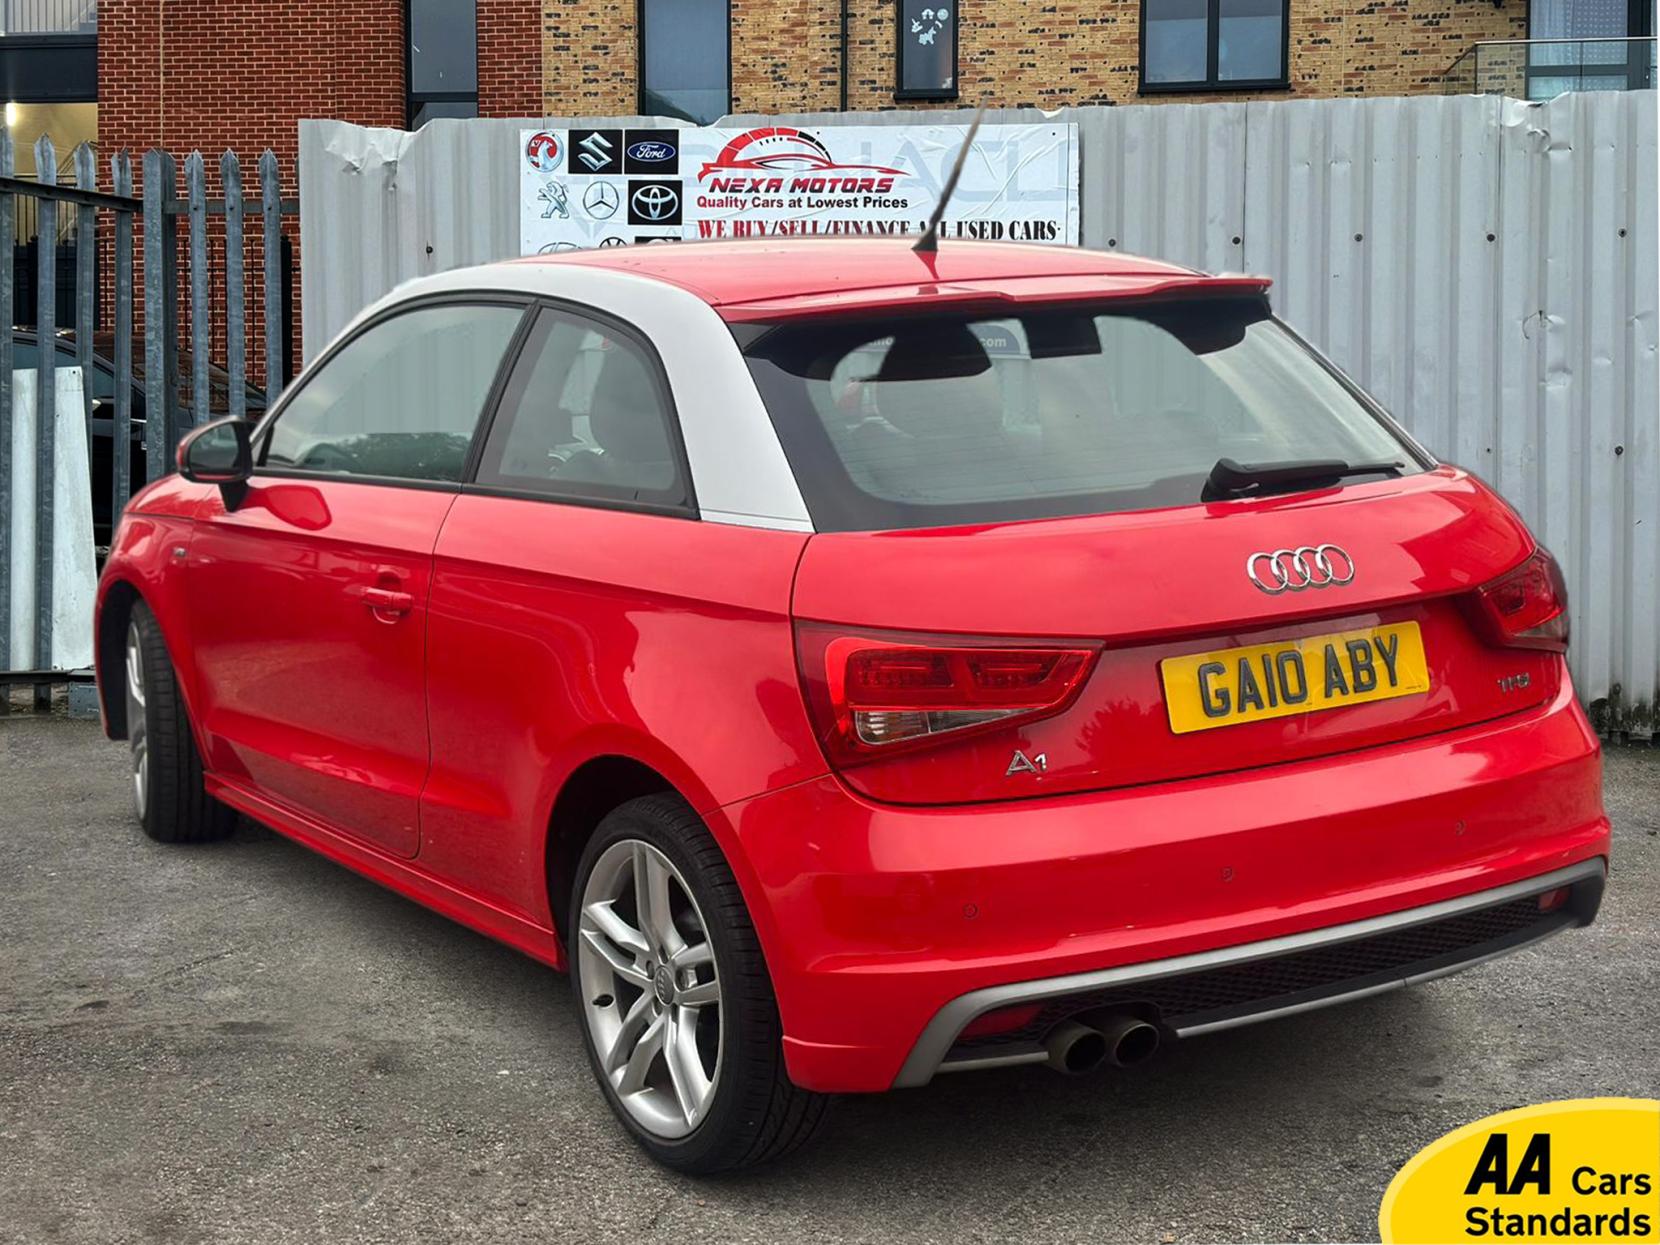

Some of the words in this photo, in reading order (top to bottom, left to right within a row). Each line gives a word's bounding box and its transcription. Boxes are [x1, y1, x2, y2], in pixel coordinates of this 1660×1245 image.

[636, 144, 666, 159] Ford
[708, 177, 784, 194] NEXA
[789, 177, 895, 194] MOTORS
[696, 195, 747, 210] Quality
[751, 195, 783, 208] Cars
[788, 196, 803, 208] at
[807, 195, 860, 208] Lowest
[863, 195, 908, 208] Prices
[698, 219, 727, 239] WE
[957, 220, 1004, 240] USED
[1009, 220, 1057, 240] CARS
[1197, 648, 1308, 719] GA10
[1324, 632, 1400, 700] ABY
[1006, 749, 1048, 777] A1
